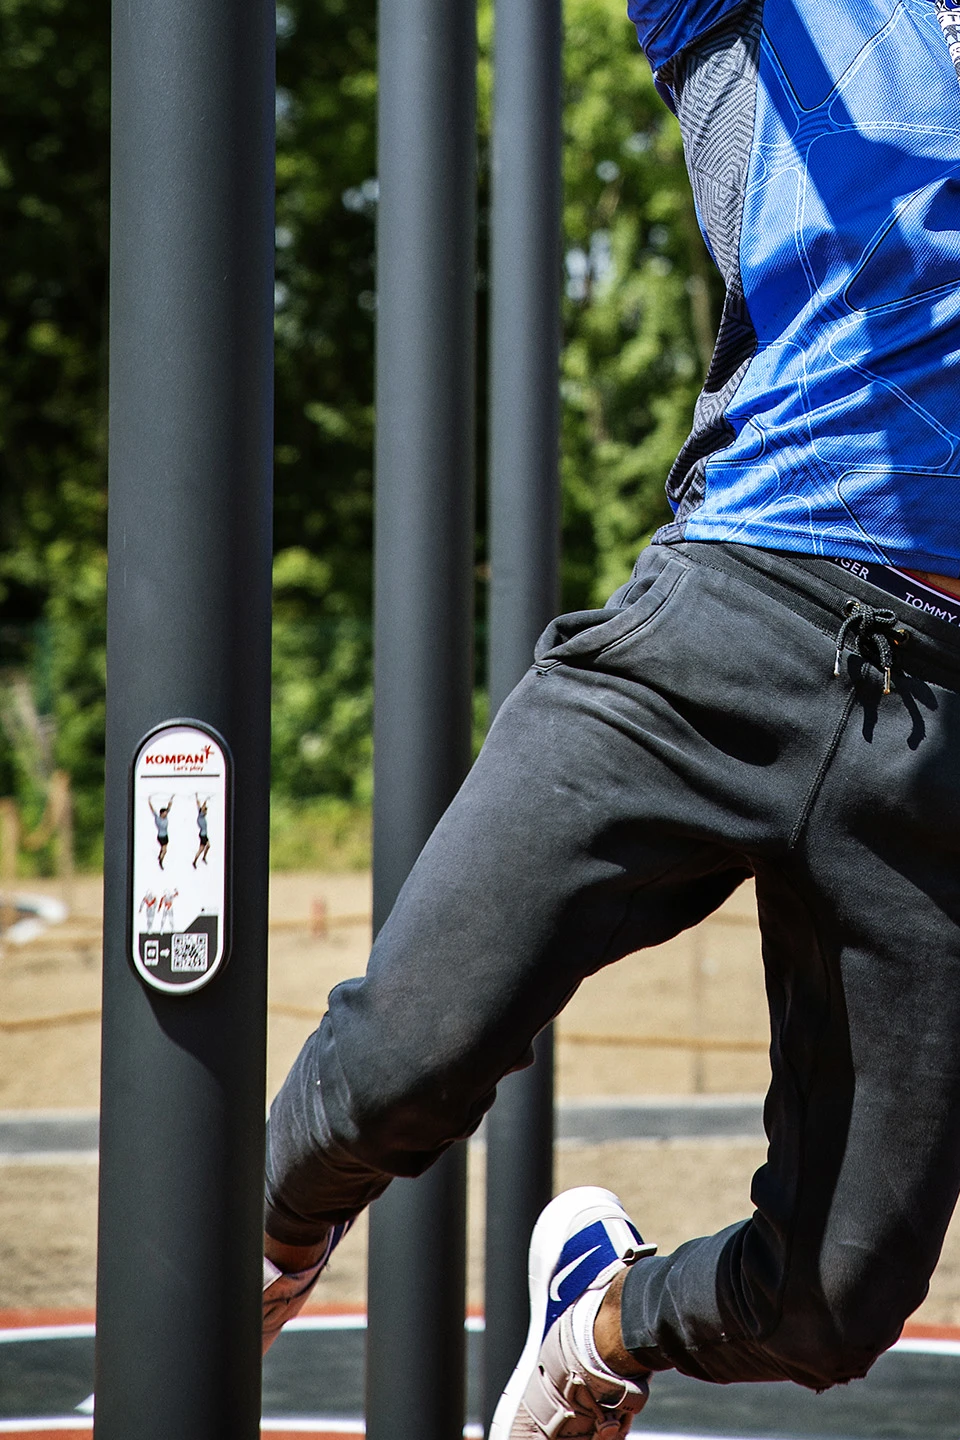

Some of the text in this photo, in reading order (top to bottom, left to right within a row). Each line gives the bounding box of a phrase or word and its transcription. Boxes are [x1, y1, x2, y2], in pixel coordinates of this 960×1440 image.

[834, 557, 870, 580] GER
[904, 592, 957, 623] TOMMY
[145, 754, 204, 765] KOMPAN
